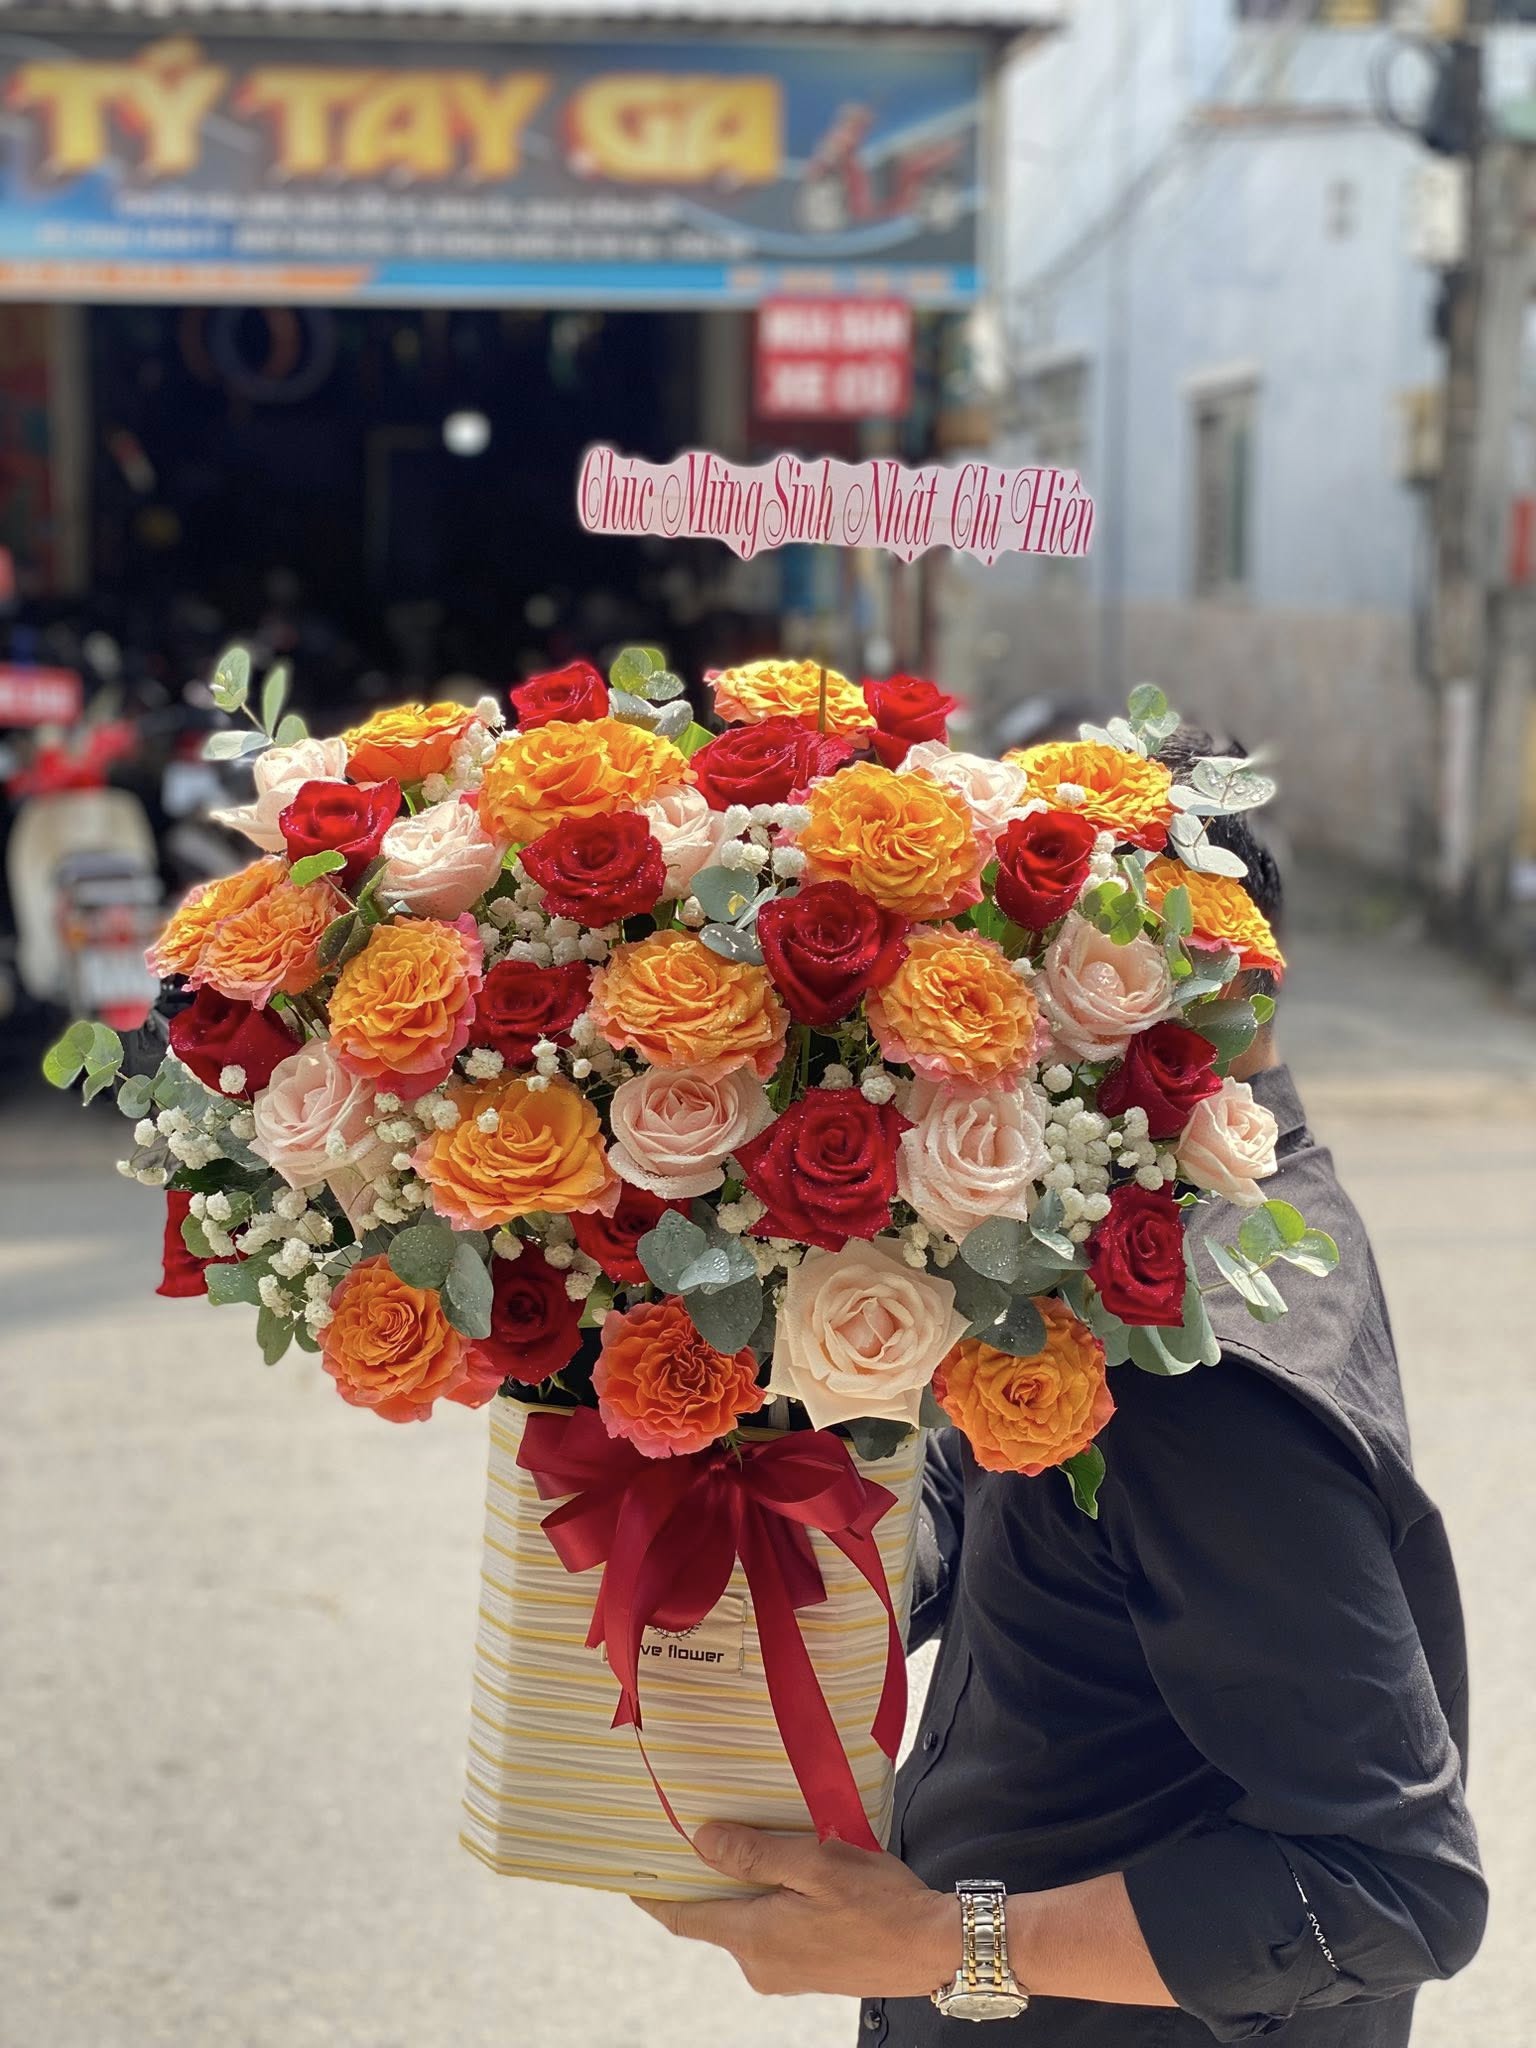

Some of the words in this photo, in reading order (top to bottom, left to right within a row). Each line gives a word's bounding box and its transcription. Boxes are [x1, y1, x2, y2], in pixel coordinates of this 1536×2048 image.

[240, 66, 550, 178] TAY
[566, 70, 784, 184] GA
[582, 449, 654, 531] Chúc
[661, 454, 763, 559] Mừng
[763, 455, 835, 546] Sinh
[843, 462, 938, 561] Nhật
[951, 464, 1005, 565] Chị
[668, 1644, 725, 1663] flower
